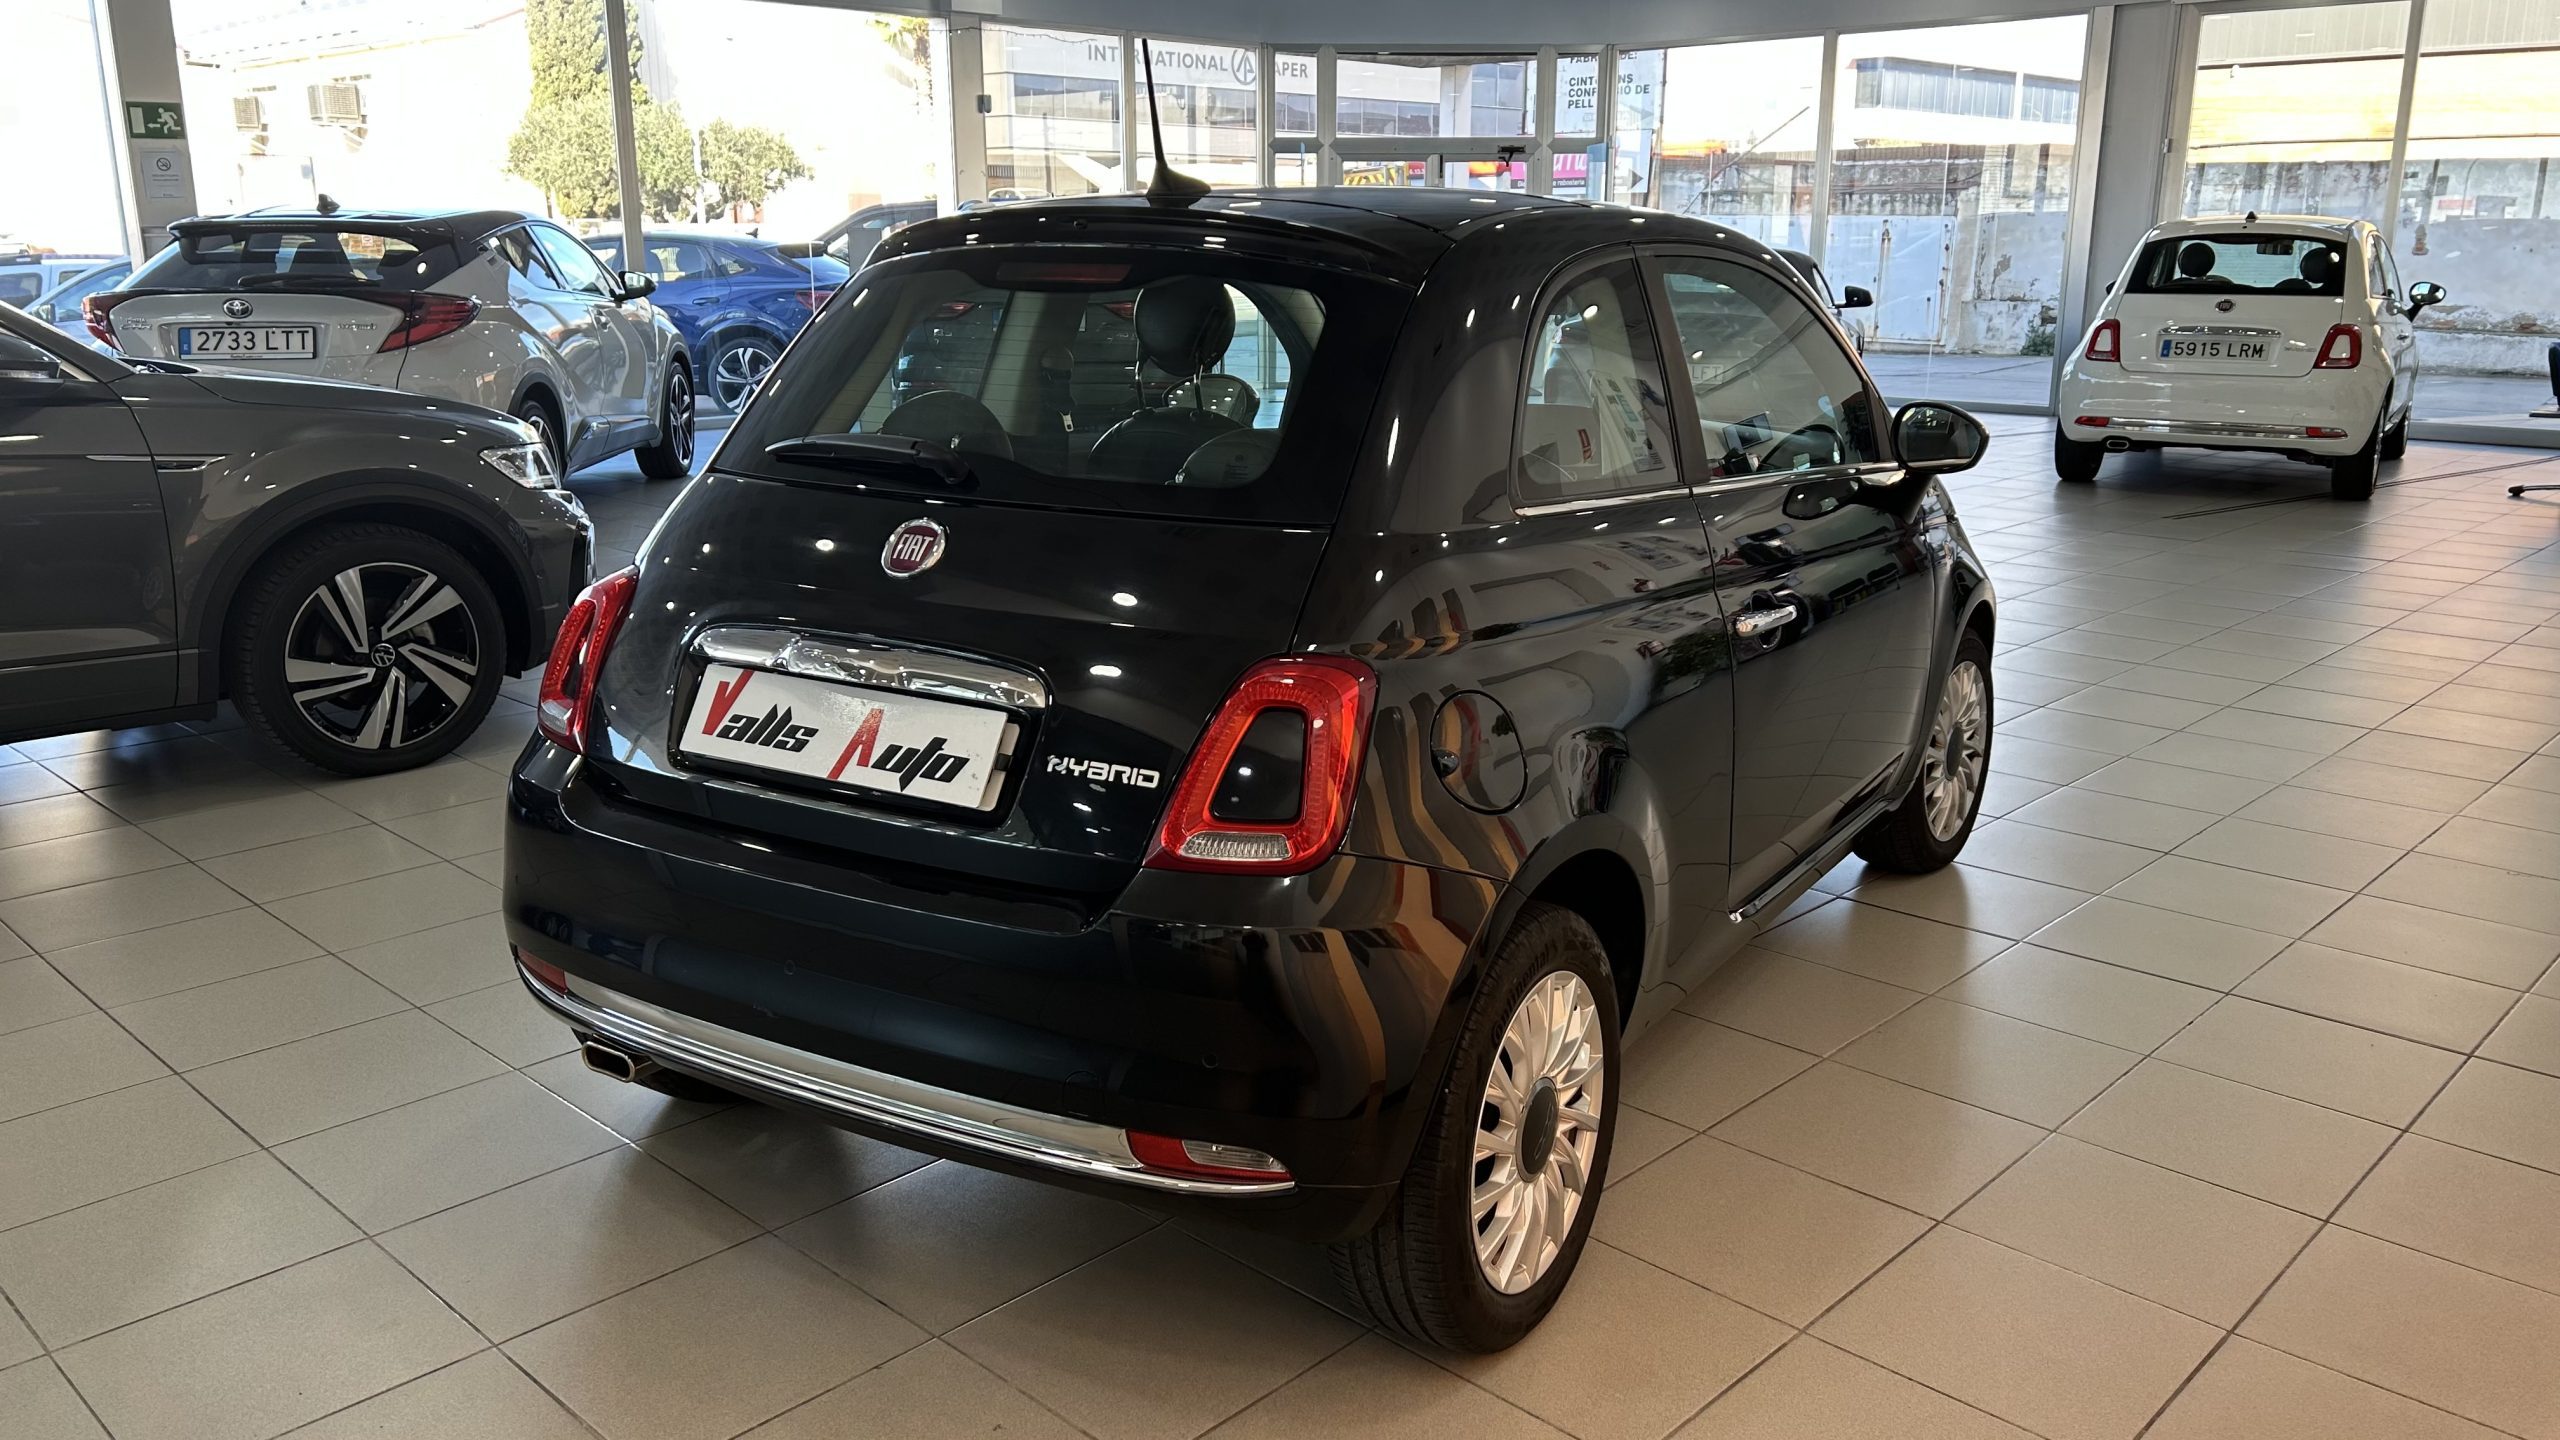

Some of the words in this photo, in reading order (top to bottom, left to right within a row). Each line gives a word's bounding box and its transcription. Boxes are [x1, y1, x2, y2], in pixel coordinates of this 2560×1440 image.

[1088, 44, 1228, 72] INTRATIONAL
[1275, 61, 1308, 79] APER
[1635, 84, 1651, 95] DE
[1567, 99, 1594, 109] PELL
[197, 331, 256, 351] 2733
[265, 329, 309, 351] LTT
[2173, 341, 2221, 357] 5915
[2226, 342, 2265, 358] LRM
[892, 533, 935, 562] FIAT
[701, 670, 819, 753] Valls
[826, 708, 971, 792] Auto
[1046, 754, 1160, 789] HYBRID
